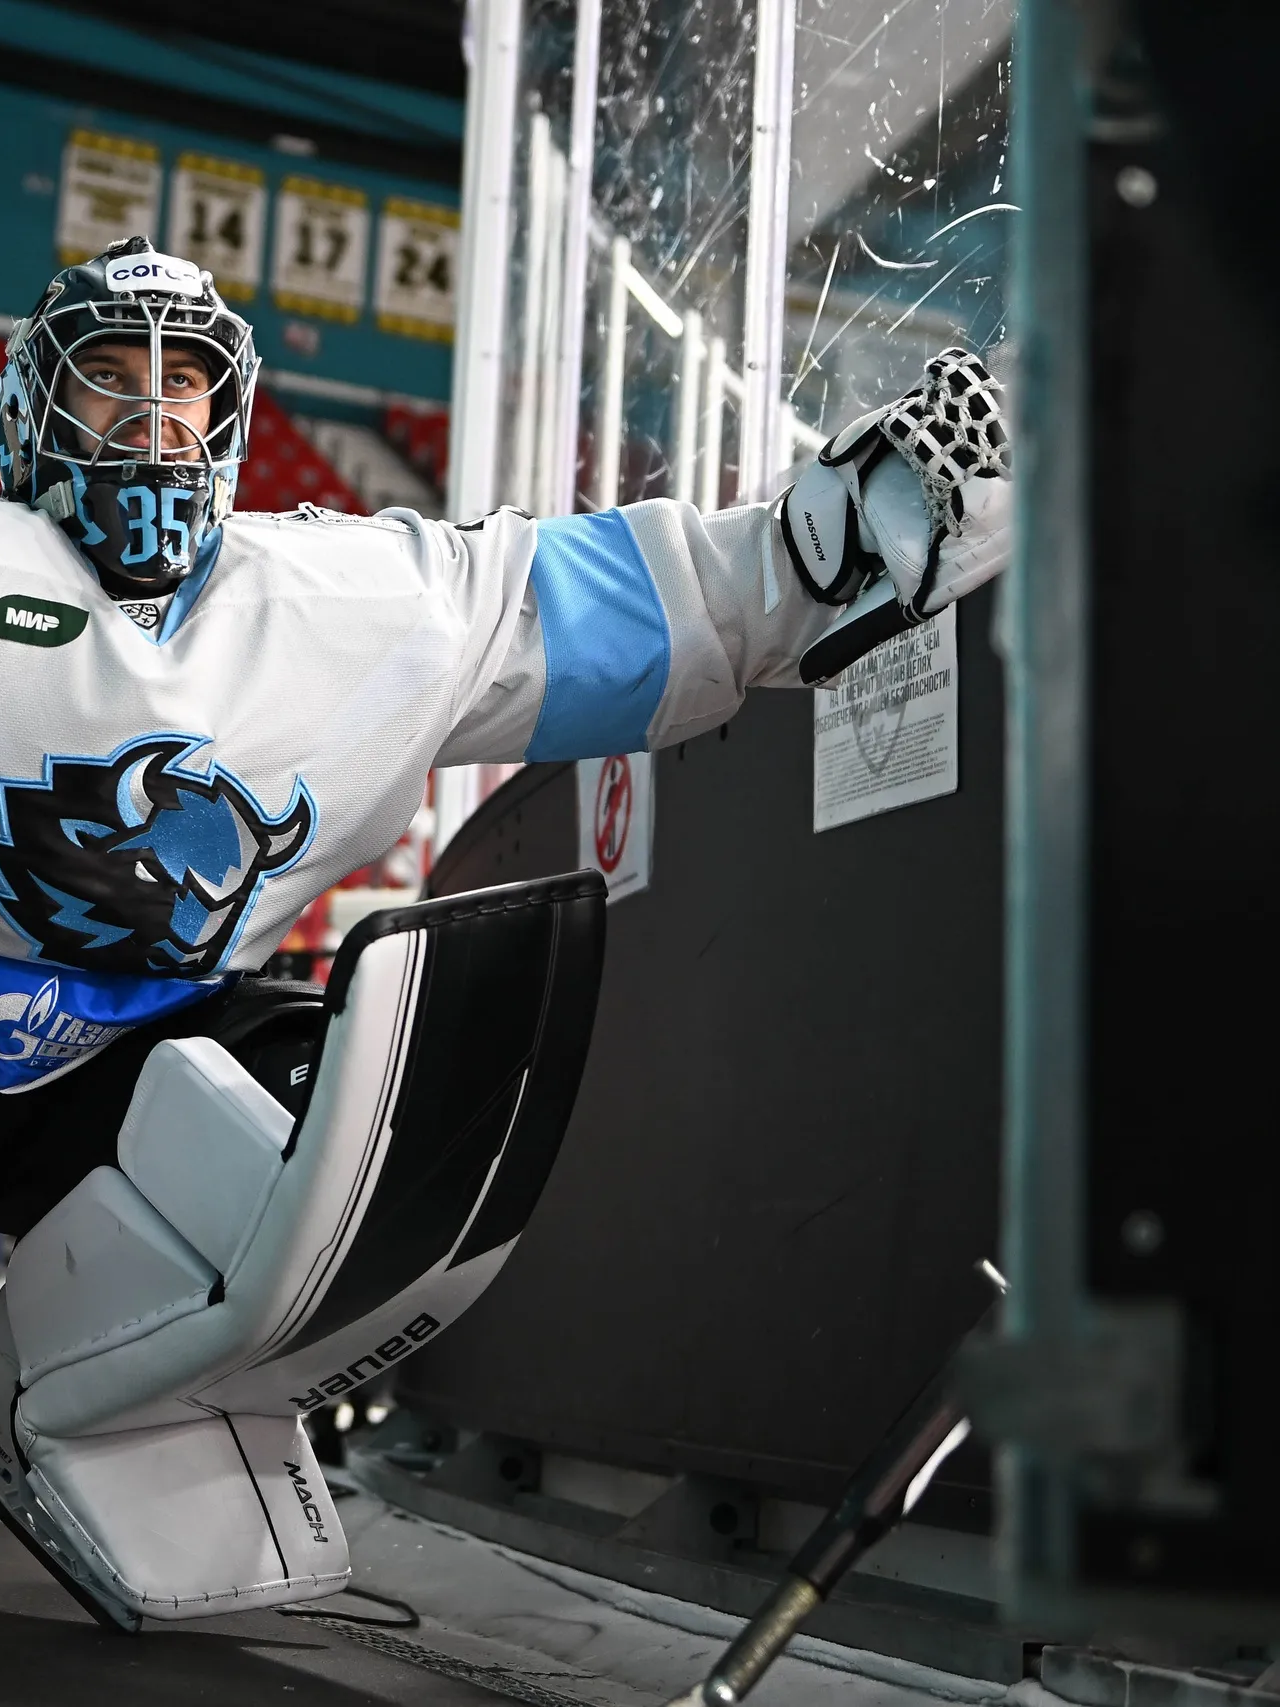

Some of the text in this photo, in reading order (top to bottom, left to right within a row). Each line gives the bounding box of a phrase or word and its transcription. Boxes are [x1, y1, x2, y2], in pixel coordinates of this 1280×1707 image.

[190, 200, 244, 249] 14
[296, 220, 348, 271] 17
[395, 245, 450, 292] 24
[117, 485, 195, 568] 35
[804, 511, 827, 561] KOLOSOV
[5, 606, 60, 632] МИР
[924, 629, 940, 652] ЧЕМ
[890, 668, 951, 707] БЕЗОПАСНОСТИ!
[906, 653, 933, 682] ЦЕЛЯХ
[283, 1460, 329, 1543] MACH
